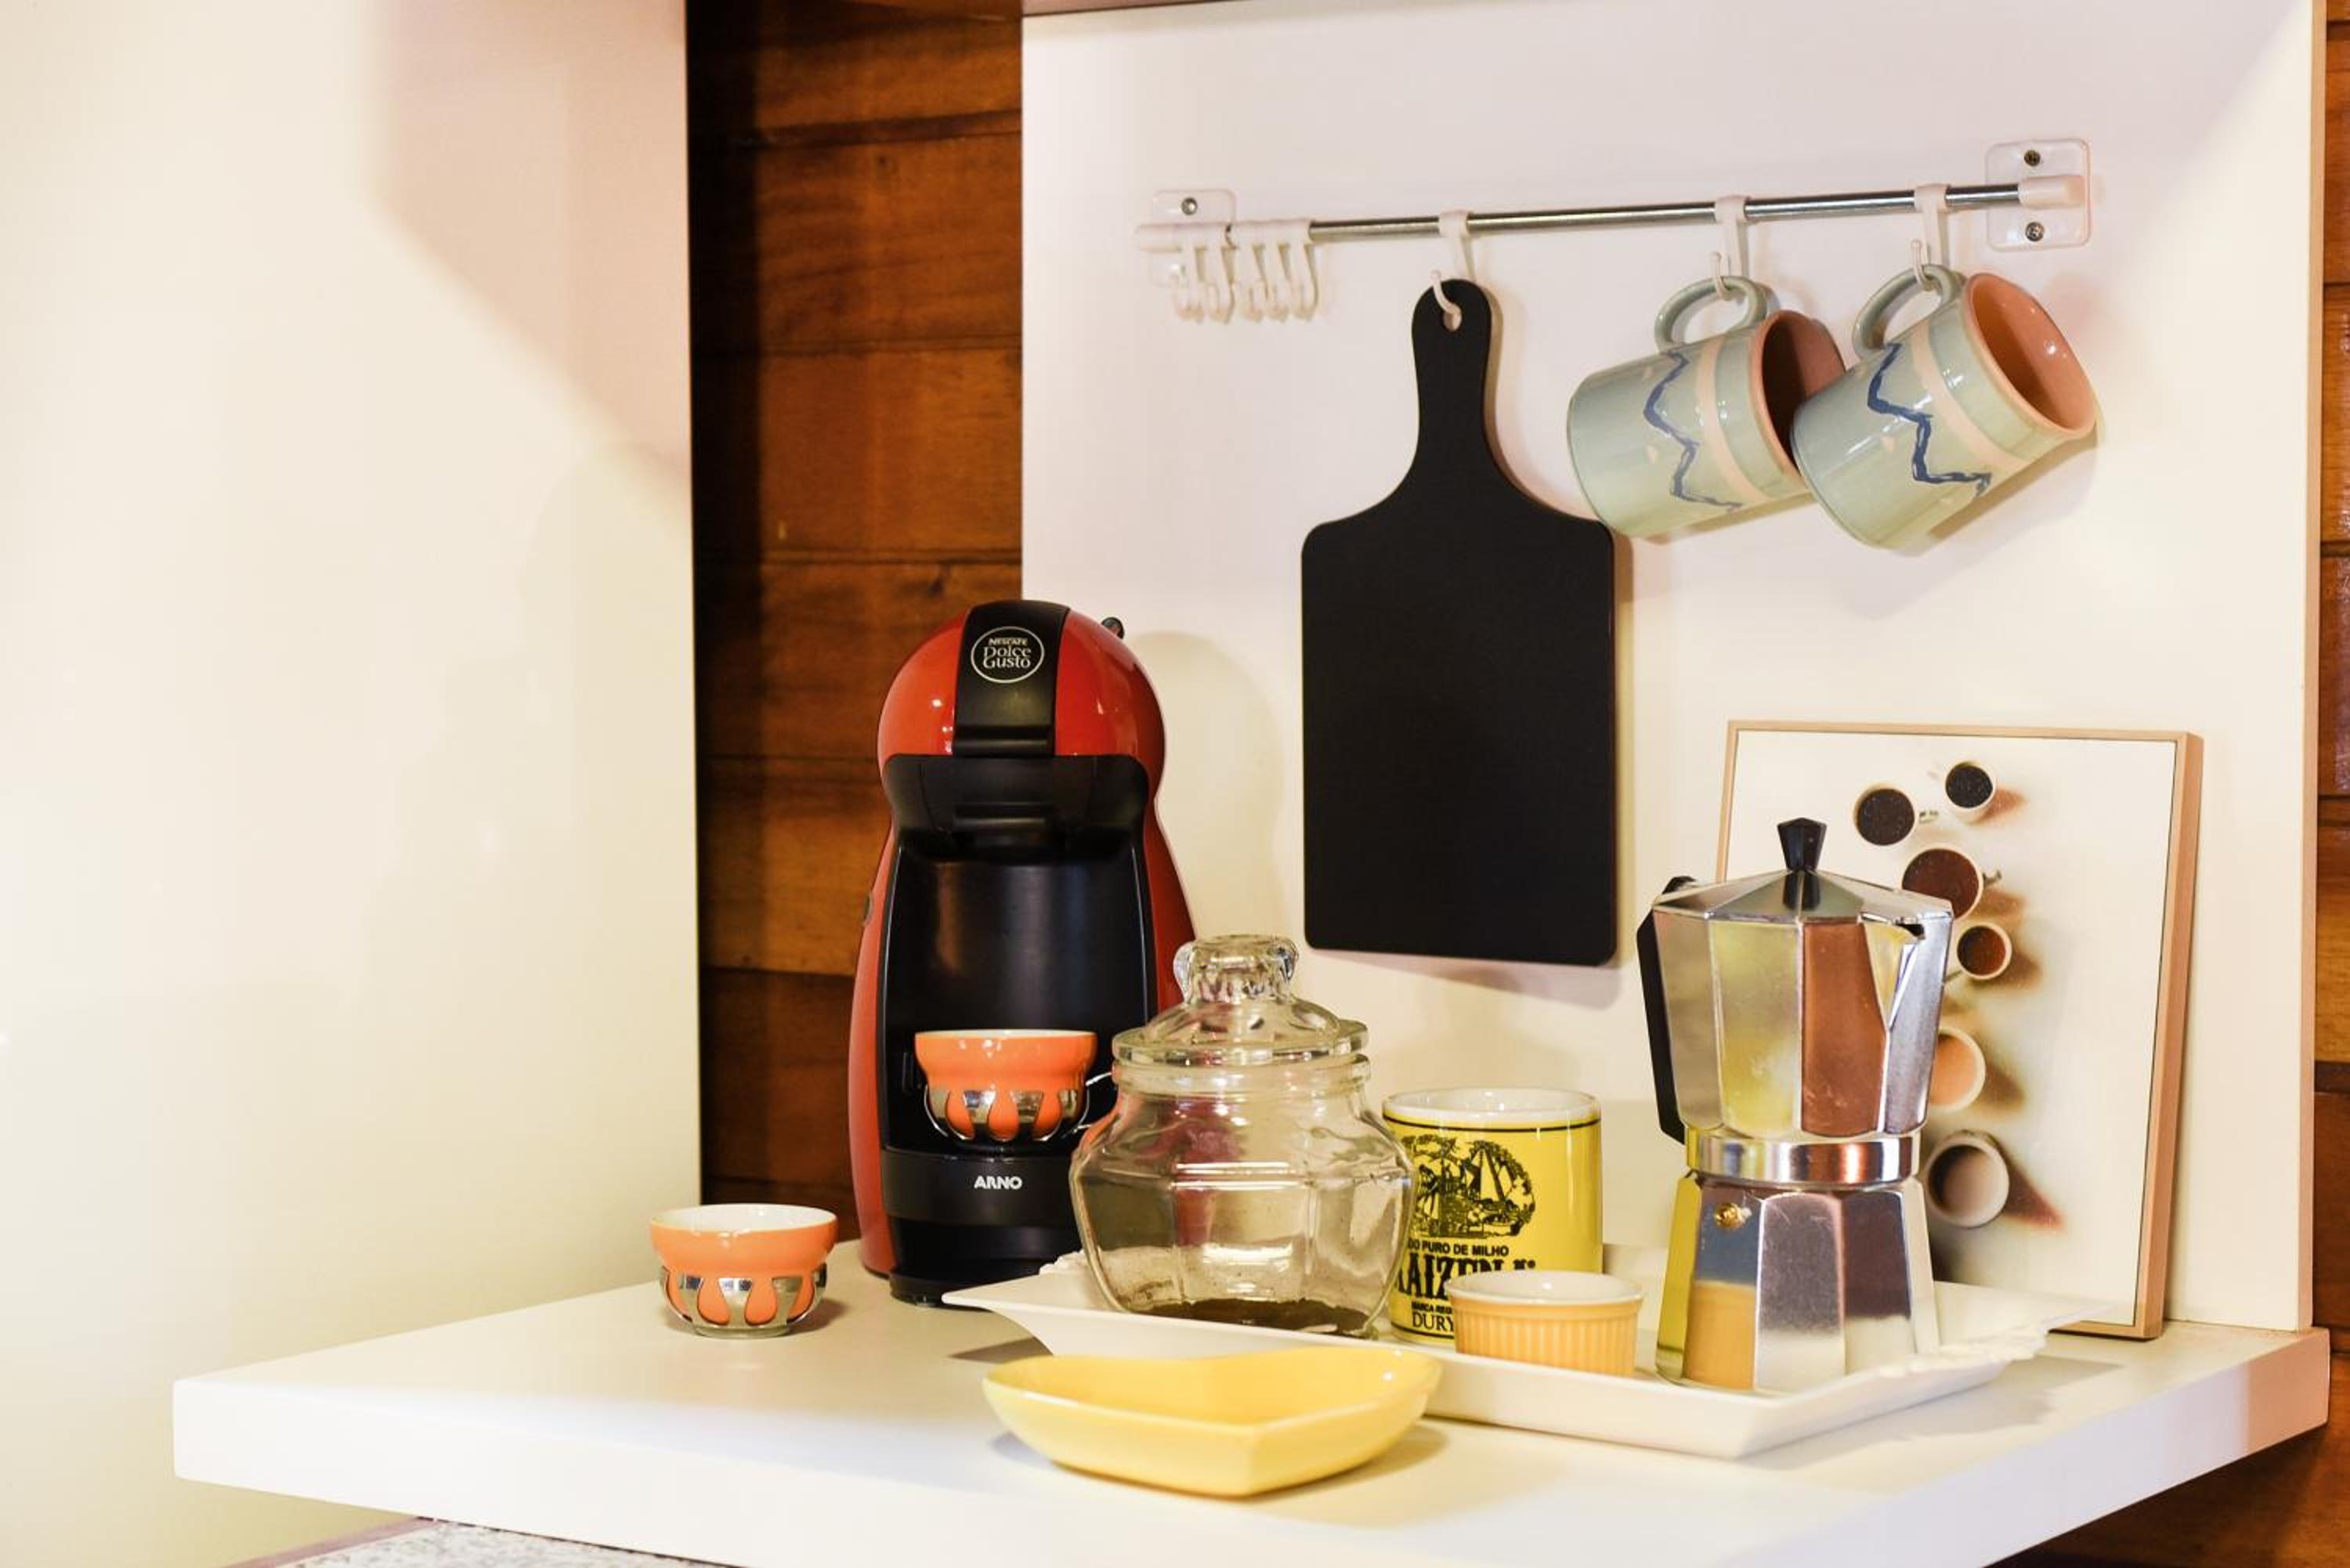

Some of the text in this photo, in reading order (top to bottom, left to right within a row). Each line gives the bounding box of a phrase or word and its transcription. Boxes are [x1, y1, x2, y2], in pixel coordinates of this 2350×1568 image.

[984, 644, 1032, 658] Dolce
[983, 656, 1031, 668] Gusto
[974, 1176, 1022, 1189] ARNO
[1422, 1240, 1451, 1254] PURO
[1453, 1243, 1469, 1255] DE
[1472, 1245, 1509, 1257] MILHO
